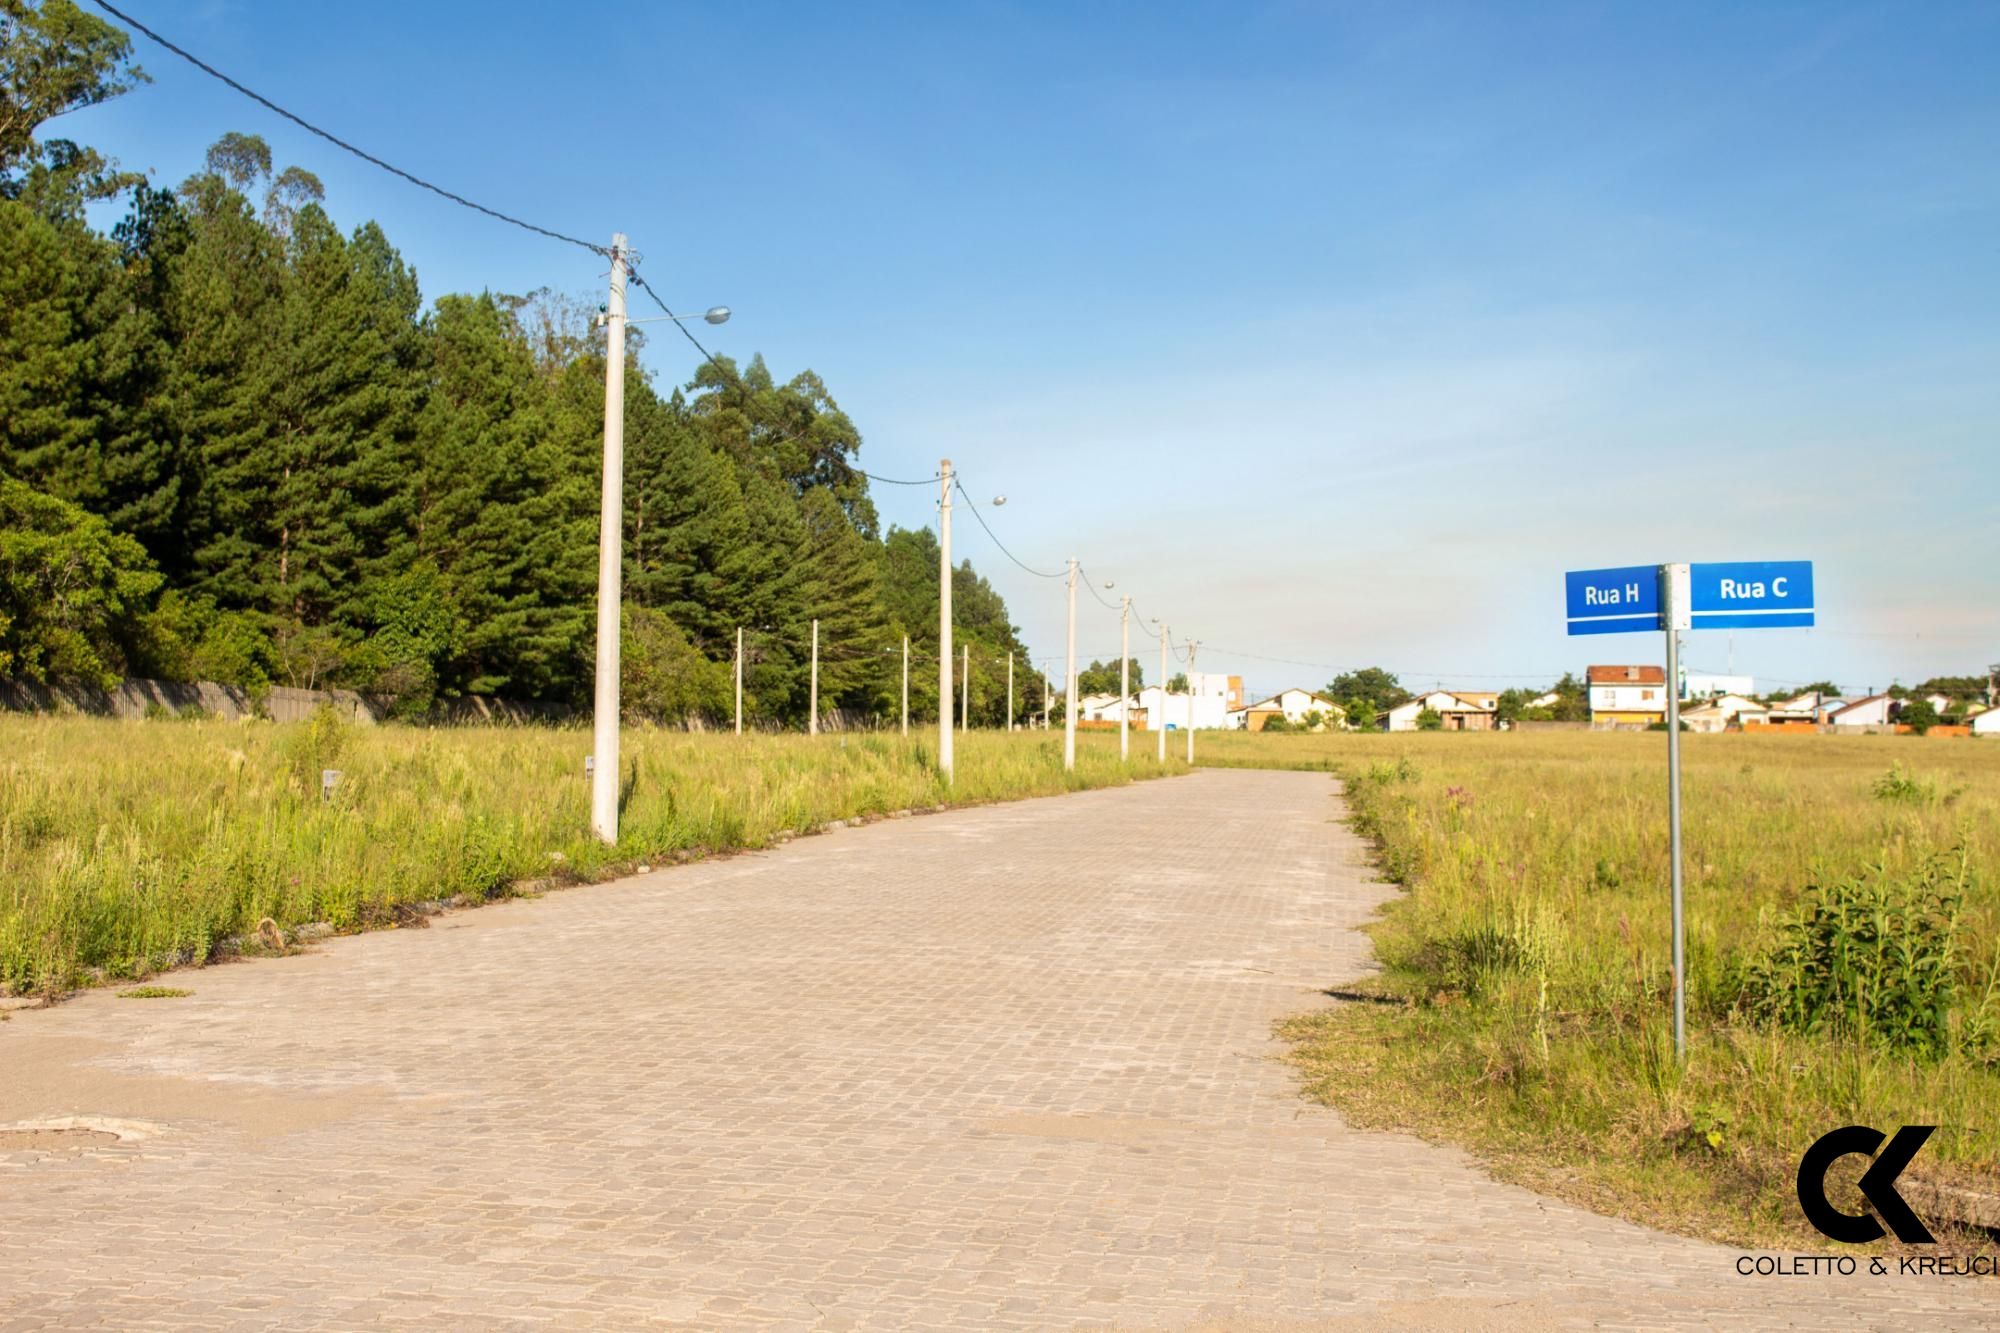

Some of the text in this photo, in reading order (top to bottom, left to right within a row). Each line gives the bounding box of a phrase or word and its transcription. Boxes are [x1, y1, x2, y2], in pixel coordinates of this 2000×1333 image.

[1585, 583, 1639, 606] Rua H
[1720, 577, 1788, 600] Rua C
